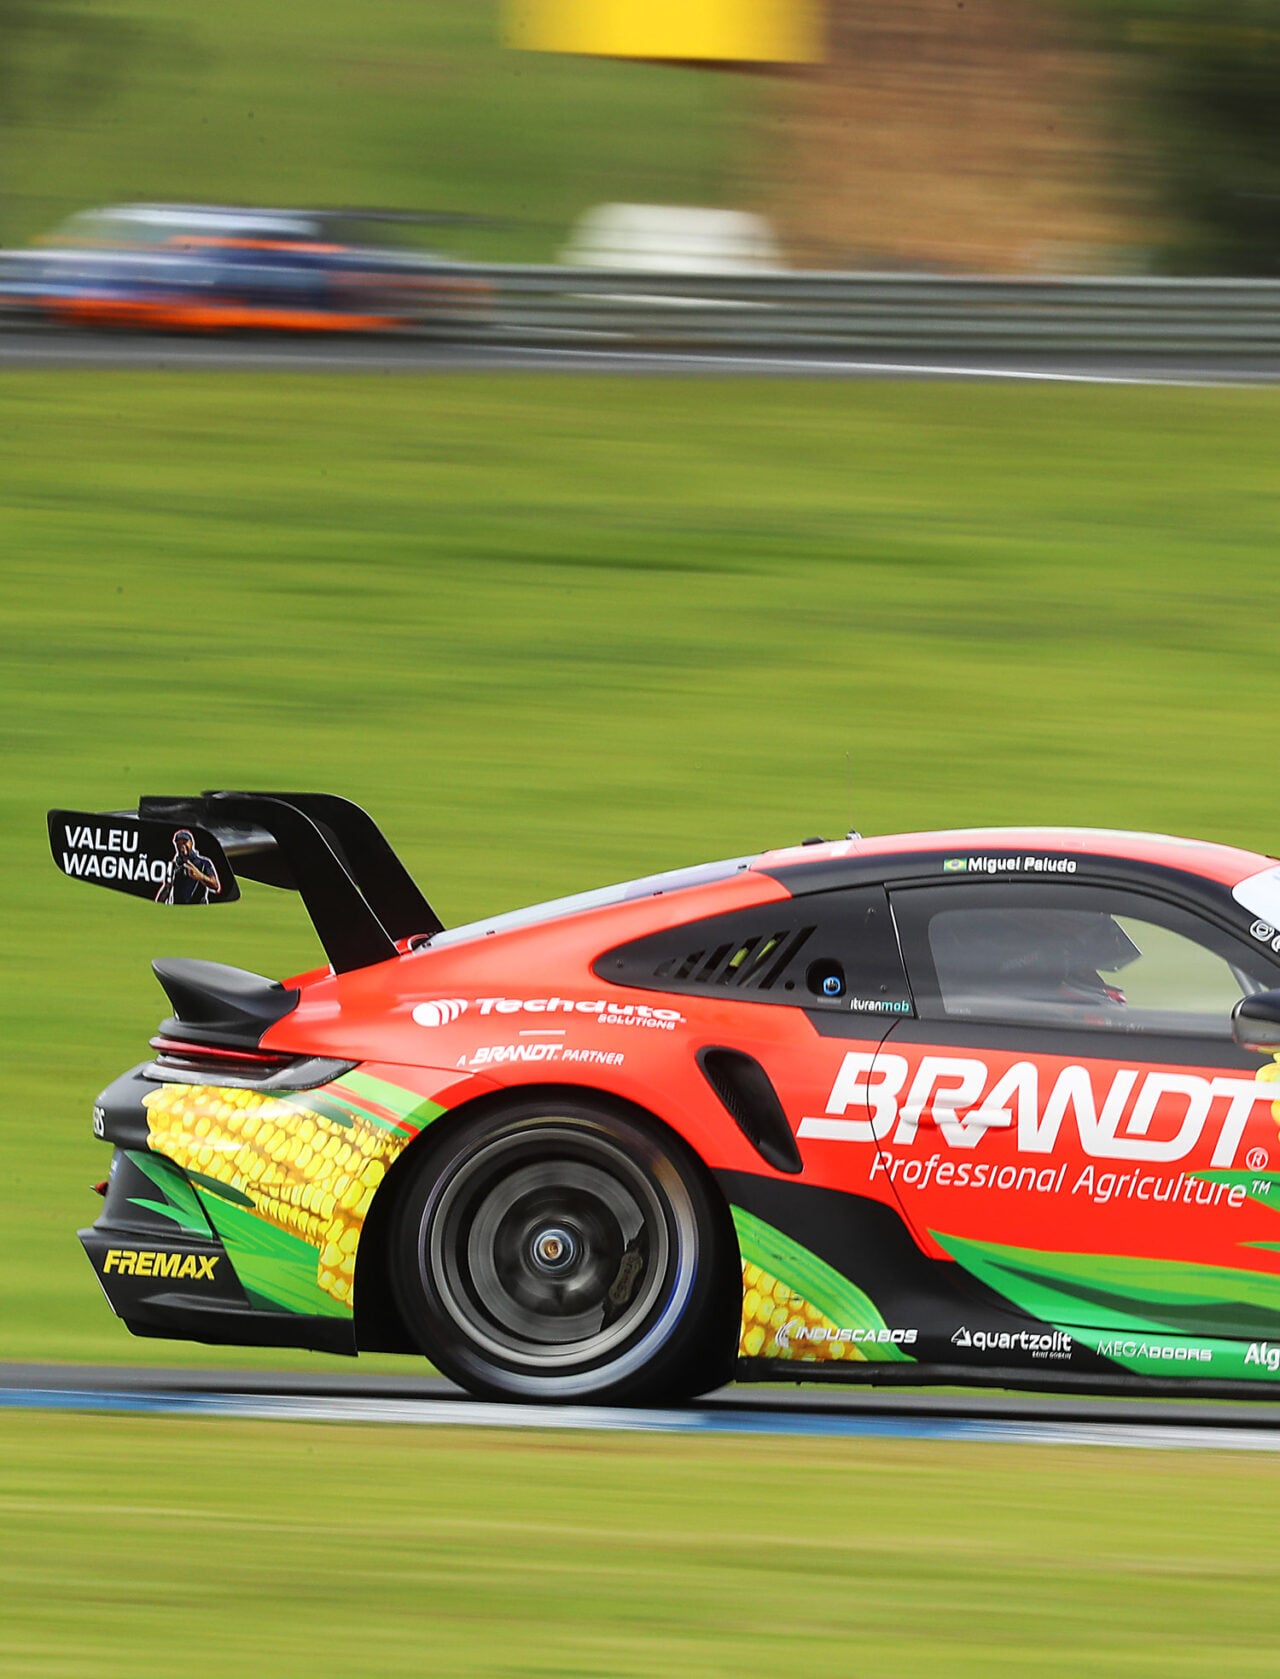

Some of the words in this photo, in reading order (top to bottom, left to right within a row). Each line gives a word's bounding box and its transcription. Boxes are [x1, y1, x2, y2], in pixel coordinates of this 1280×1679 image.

[65, 825, 138, 853] VALEU
[63, 852, 173, 883] WAGNÃO!
[967, 857, 1021, 874] Miguel
[1024, 857, 1077, 873] Paludo
[850, 997, 910, 1013] ituranmob
[598, 1014, 676, 1031] SOLUTIONS
[456, 1054, 467, 1068] A
[469, 1044, 563, 1065] BRANDT
[562, 1049, 625, 1065] PARTNER
[869, 1151, 1068, 1192] Professional
[1071, 1165, 1247, 1207] Agriculture
[103, 1249, 219, 1280] FREMAX
[795, 1326, 919, 1343] INDUSCABOS
[973, 1330, 1072, 1351] quartzolit
[1096, 1340, 1212, 1362] MEGADOORS
